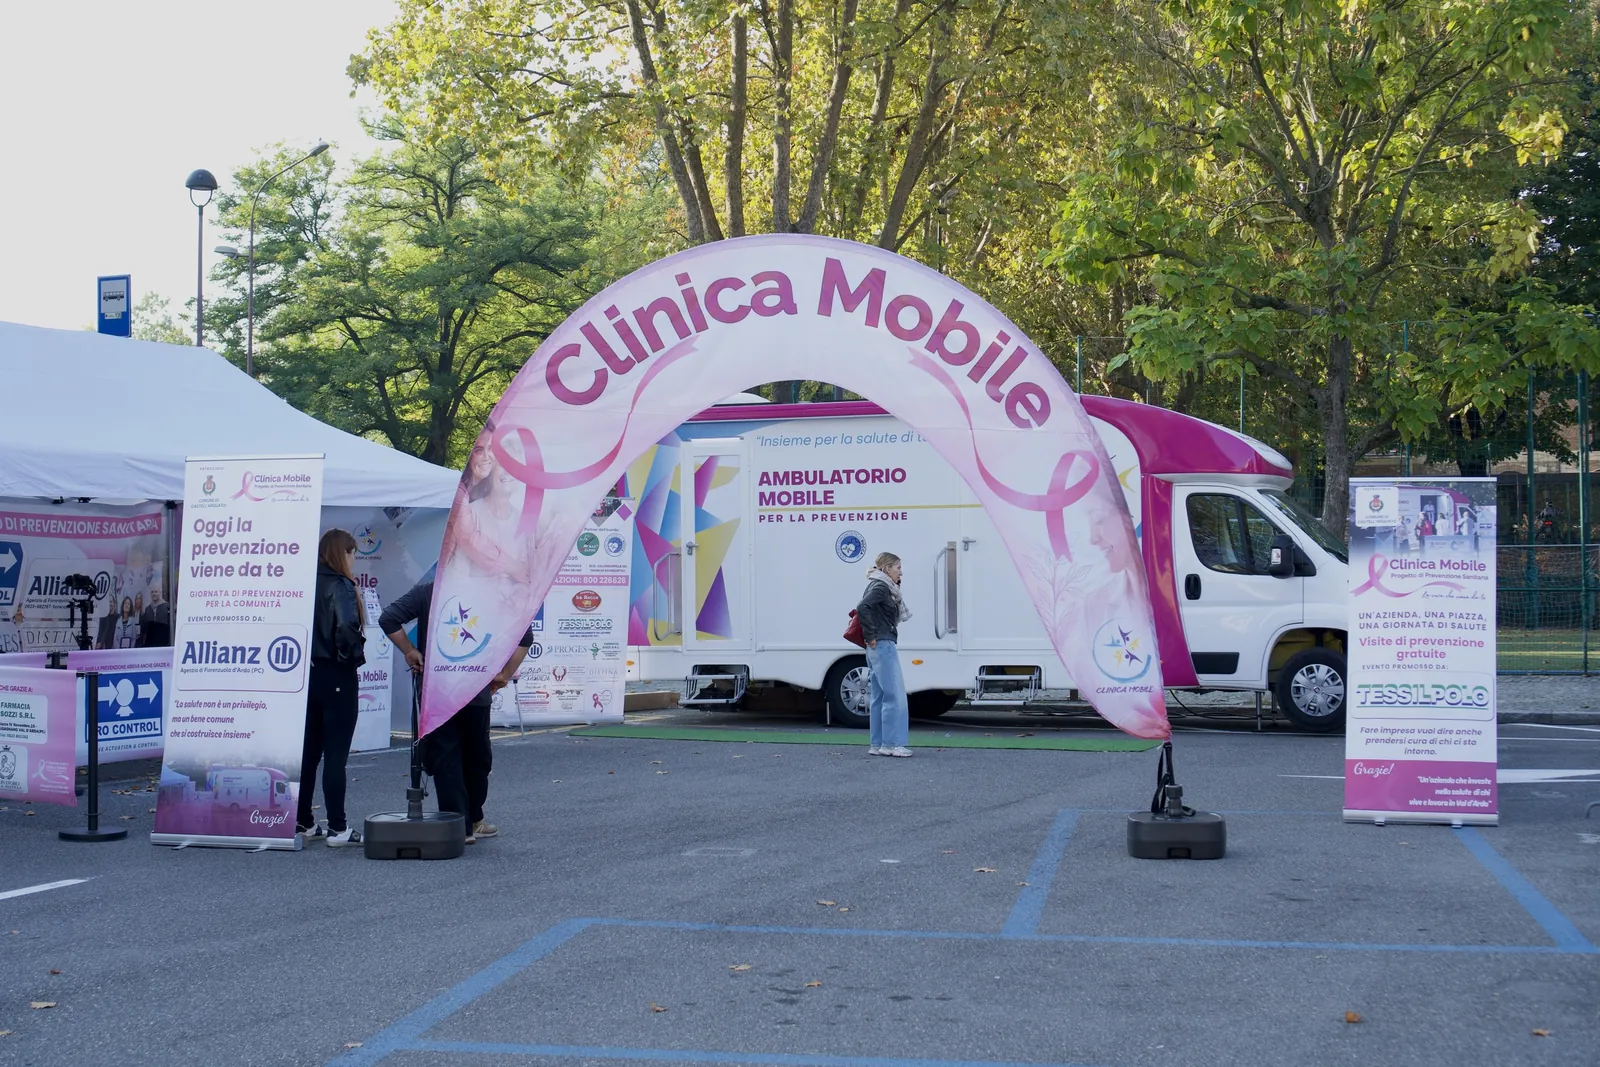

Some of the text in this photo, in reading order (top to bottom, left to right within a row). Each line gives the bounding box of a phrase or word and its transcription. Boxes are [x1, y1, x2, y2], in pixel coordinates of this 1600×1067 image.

[546, 257, 1051, 429] Clinica Mobile
[815, 434, 838, 448] per
[841, 432, 853, 445] la
[857, 432, 897, 445] salute
[901, 431, 913, 442] di
[283, 474, 311, 482] Mobile
[758, 468, 907, 486] AMBULATORIO
[758, 490, 834, 506] MOBILE
[759, 512, 908, 523] PER LA PREVENZIONE
[5, 517, 17, 530] DI
[20, 518, 100, 534] PREVENZIONE
[194, 516, 252, 538] Oggi la
[192, 538, 300, 561] prevenzione
[190, 561, 284, 578] viene da te
[1390, 559, 1486, 571] Clinica Mobile
[190, 590, 229, 598] GIORNATA
[242, 590, 304, 598] PREVENZIONE
[206, 600, 219, 608] PER
[233, 599, 282, 608] COMUNITÀ
[1359, 611, 1487, 621] UN'AZIENDA, UNA PIAZZA,
[558, 618, 613, 630] TESSILPOLO
[1383, 621, 1434, 629] GIORNATA
[1438, 621, 1447, 629] DI
[1451, 622, 1487, 630] SALUTE
[1359, 636, 1484, 648] Visite di prevenzione
[182, 640, 261, 664] Allianz
[554, 645, 587, 653] PROGES
[1396, 649, 1446, 661] gratuite
[363, 670, 387, 682] Mobile
[1096, 686, 1127, 694] CLINICA
[1357, 684, 1489, 707] TESSILPOLO
[1, 702, 30, 710] FARMACIA
[184, 700, 202, 708] salute
[232, 701, 268, 711] privilegio,
[190, 715, 205, 723] bene
[206, 716, 234, 724] comune
[112, 721, 158, 735] CONTROL
[187, 730, 222, 738] costruisce
[1380, 727, 1415, 736] impresa
[1417, 727, 1435, 735] vuol
[1438, 727, 1454, 735] dire
[1456, 728, 1482, 736] anche
[105, 743, 132, 751] ACTUATION
[1366, 737, 1406, 745] prendersi
[1429, 737, 1437, 745] di
[1354, 762, 1395, 778] Grazie!
[1468, 777, 1491, 785] investe
[250, 810, 289, 827] Grazie!
